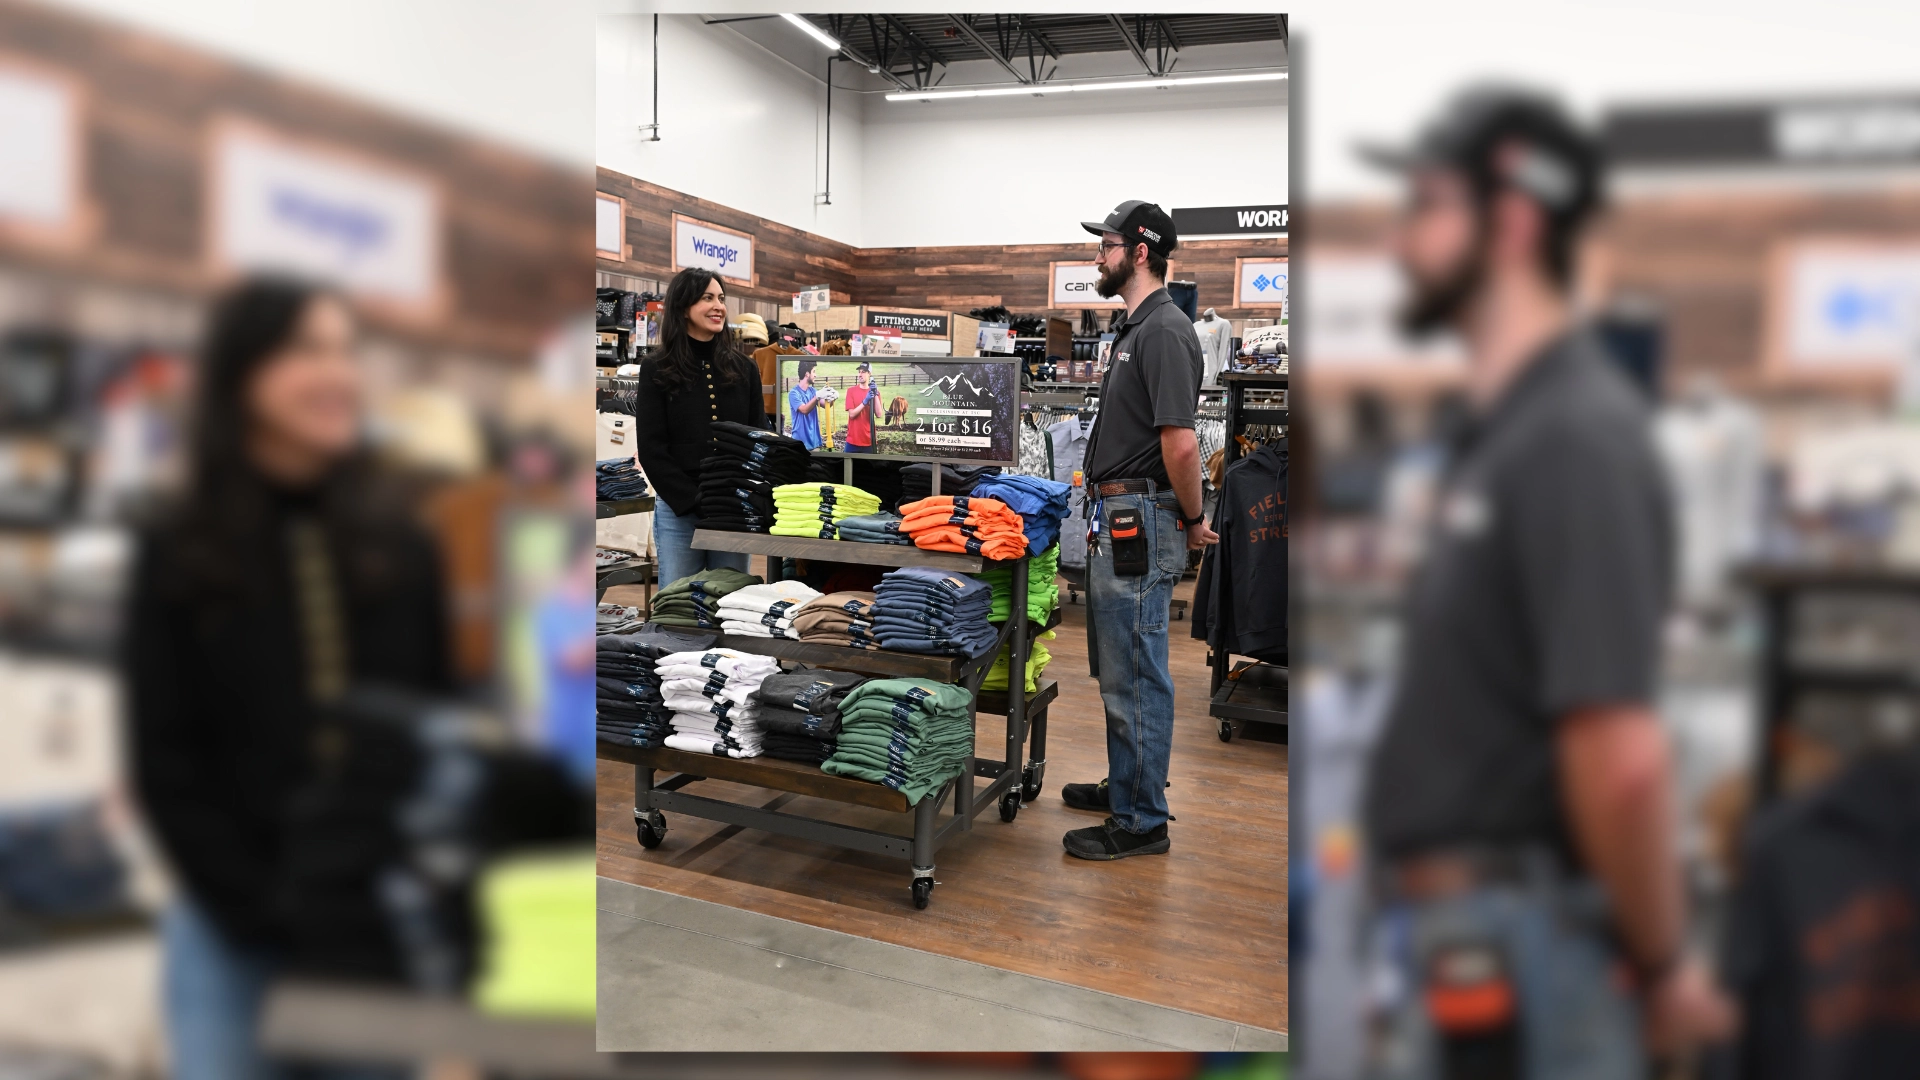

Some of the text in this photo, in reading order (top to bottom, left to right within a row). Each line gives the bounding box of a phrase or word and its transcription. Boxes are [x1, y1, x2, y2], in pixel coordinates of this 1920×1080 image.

[692, 236, 738, 267] Wrangler
[874, 316, 940, 327] FITTING ROOM
[916, 417, 992, 435] 2 for $16
